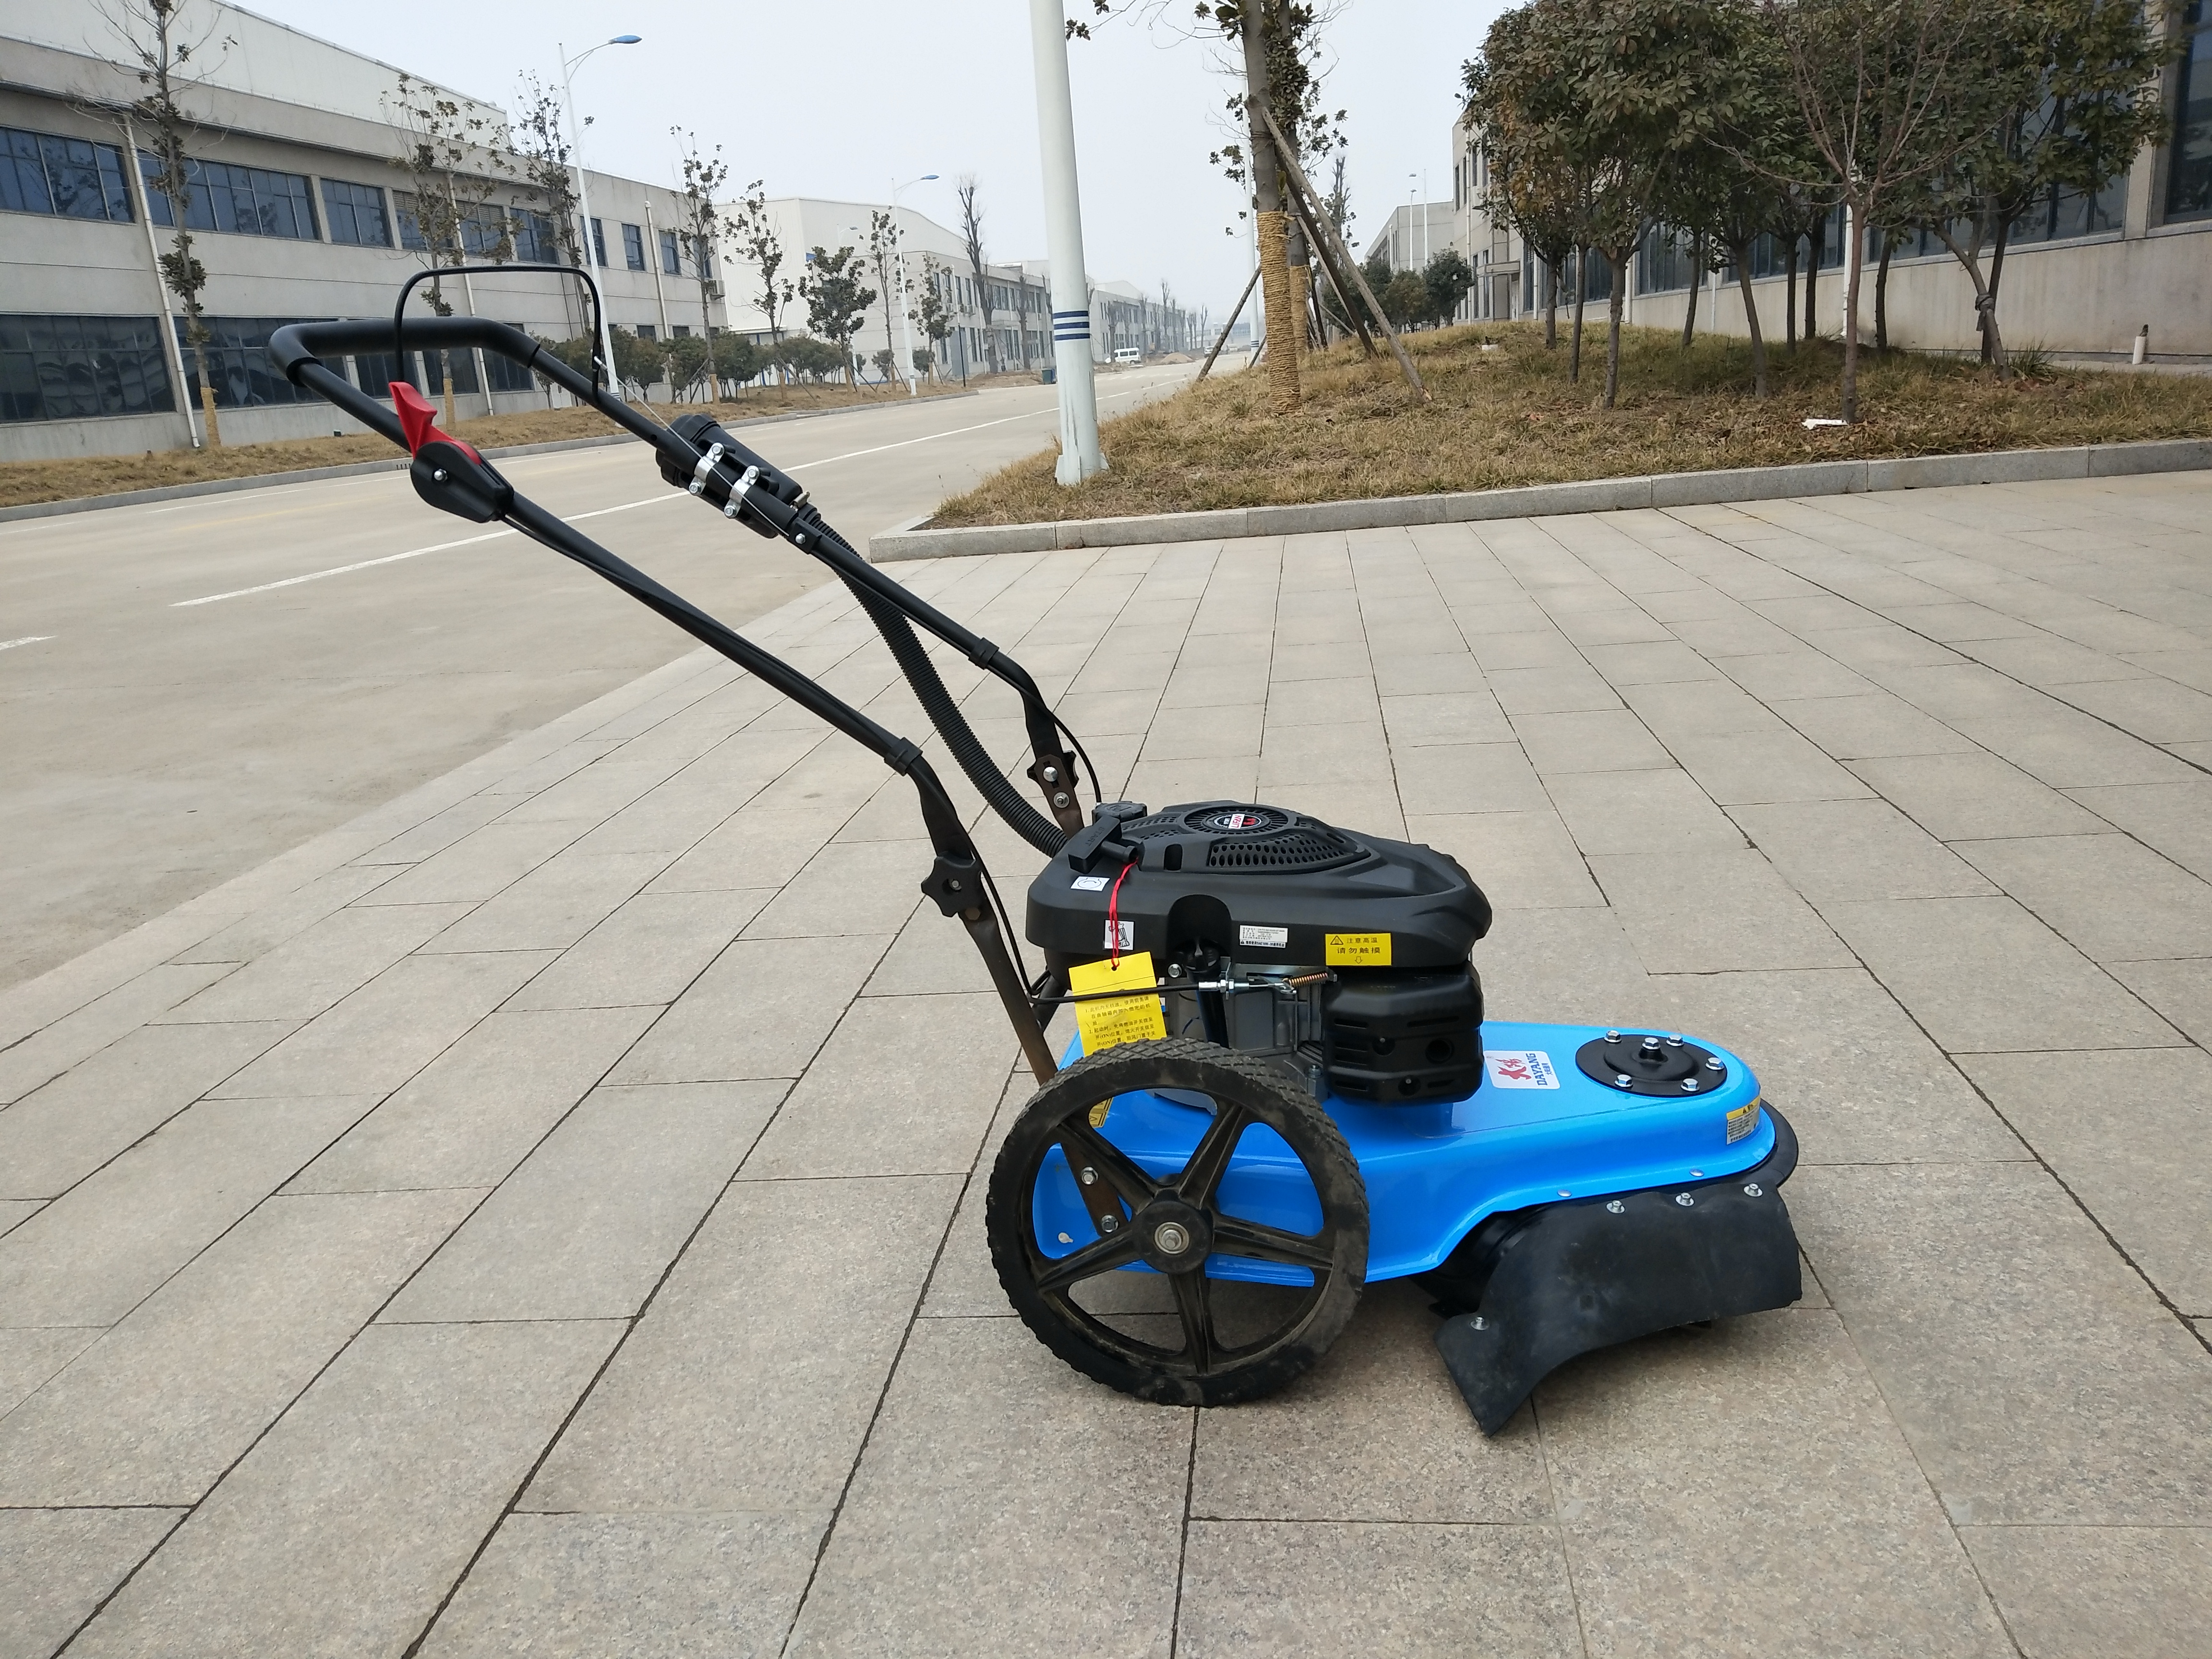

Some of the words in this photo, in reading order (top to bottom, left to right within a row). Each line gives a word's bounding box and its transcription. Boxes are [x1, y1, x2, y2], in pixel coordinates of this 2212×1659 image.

[1231, 815, 1242, 828] LIFAN
[1085, 827, 1105, 846] START
[1526, 1053, 1548, 1086] DAYANG
